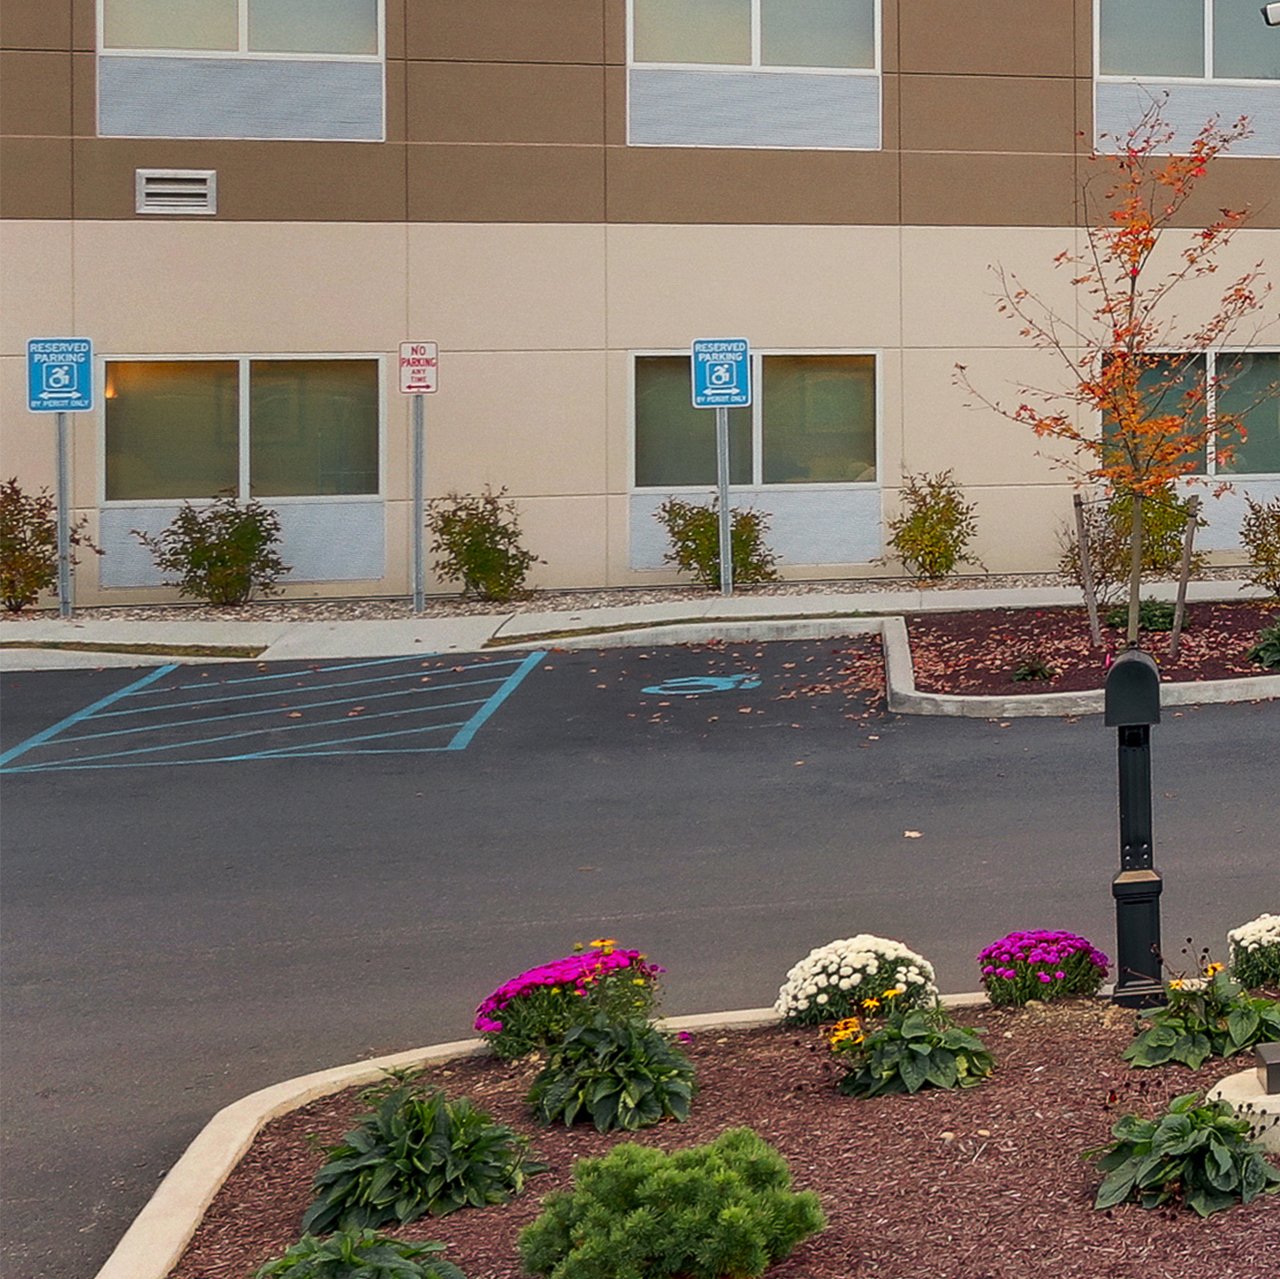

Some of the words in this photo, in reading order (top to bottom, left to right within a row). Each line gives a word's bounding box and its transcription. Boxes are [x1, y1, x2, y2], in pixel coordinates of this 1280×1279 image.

[30, 342, 89, 353] RESERVED
[411, 345, 426, 356] NO
[695, 342, 746, 353] RESERVED
[34, 352, 86, 363] PARKING
[401, 357, 437, 368] PARKING
[698, 352, 743, 362] PARKING
